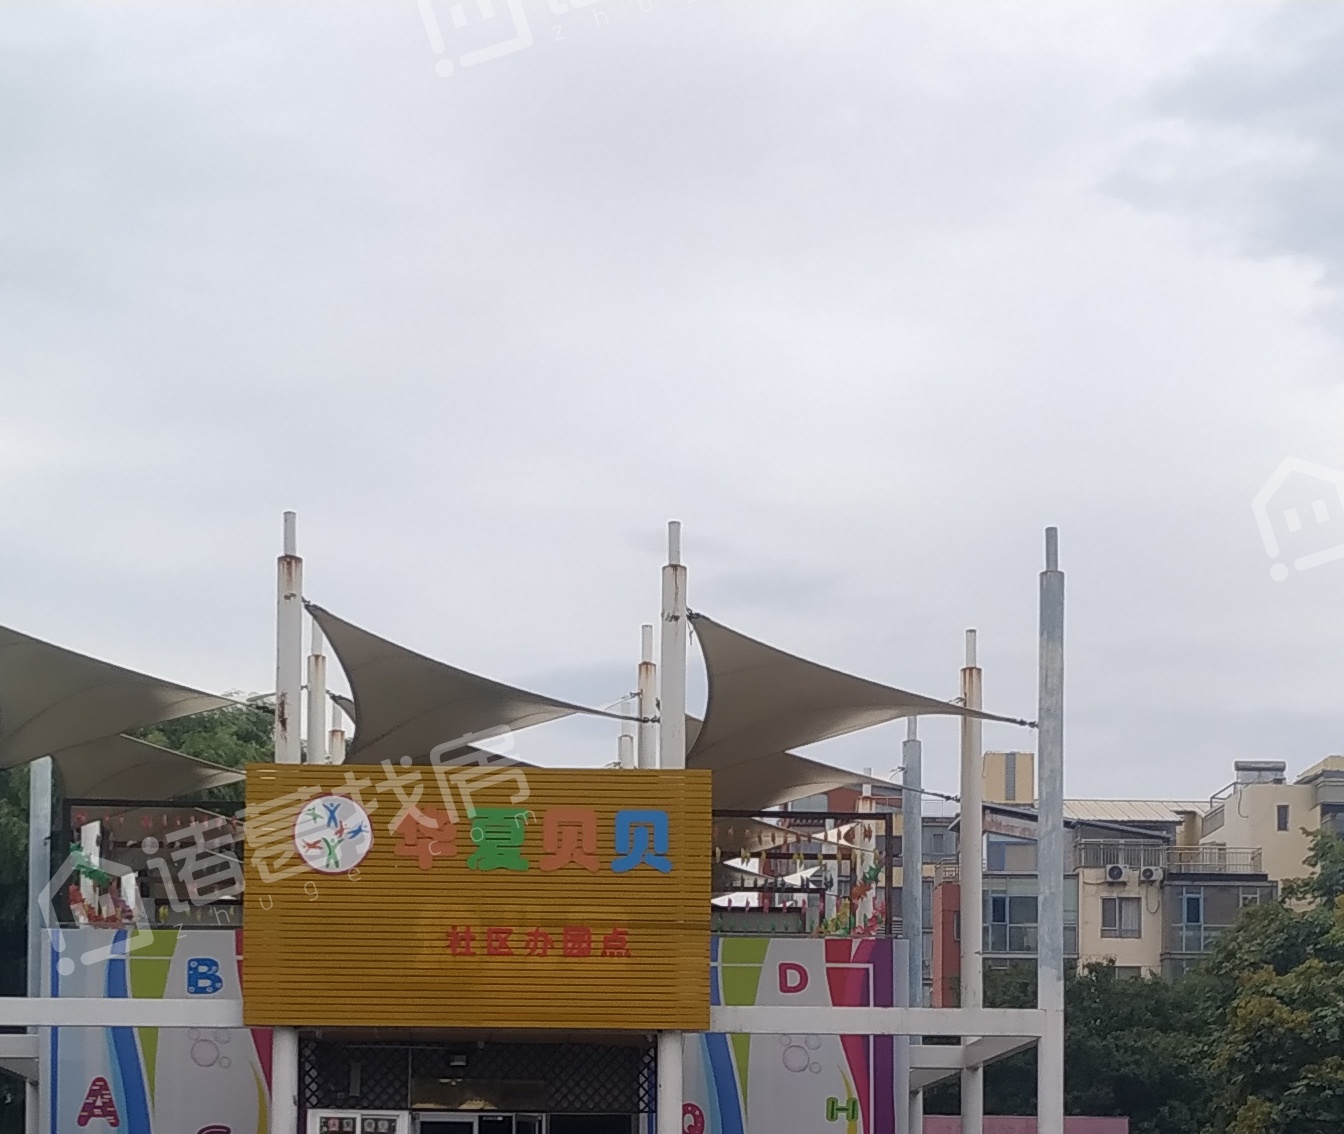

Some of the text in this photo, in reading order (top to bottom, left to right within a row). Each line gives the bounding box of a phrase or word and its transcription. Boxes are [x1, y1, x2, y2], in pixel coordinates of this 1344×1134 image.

[394, 805, 673, 873] 华夏贝贝
[446, 924, 632, 957] 社区办园点
[187, 958, 223, 994] B
[778, 962, 809, 993] D
[77, 1077, 120, 1127] A
[826, 1097, 858, 1122] H
